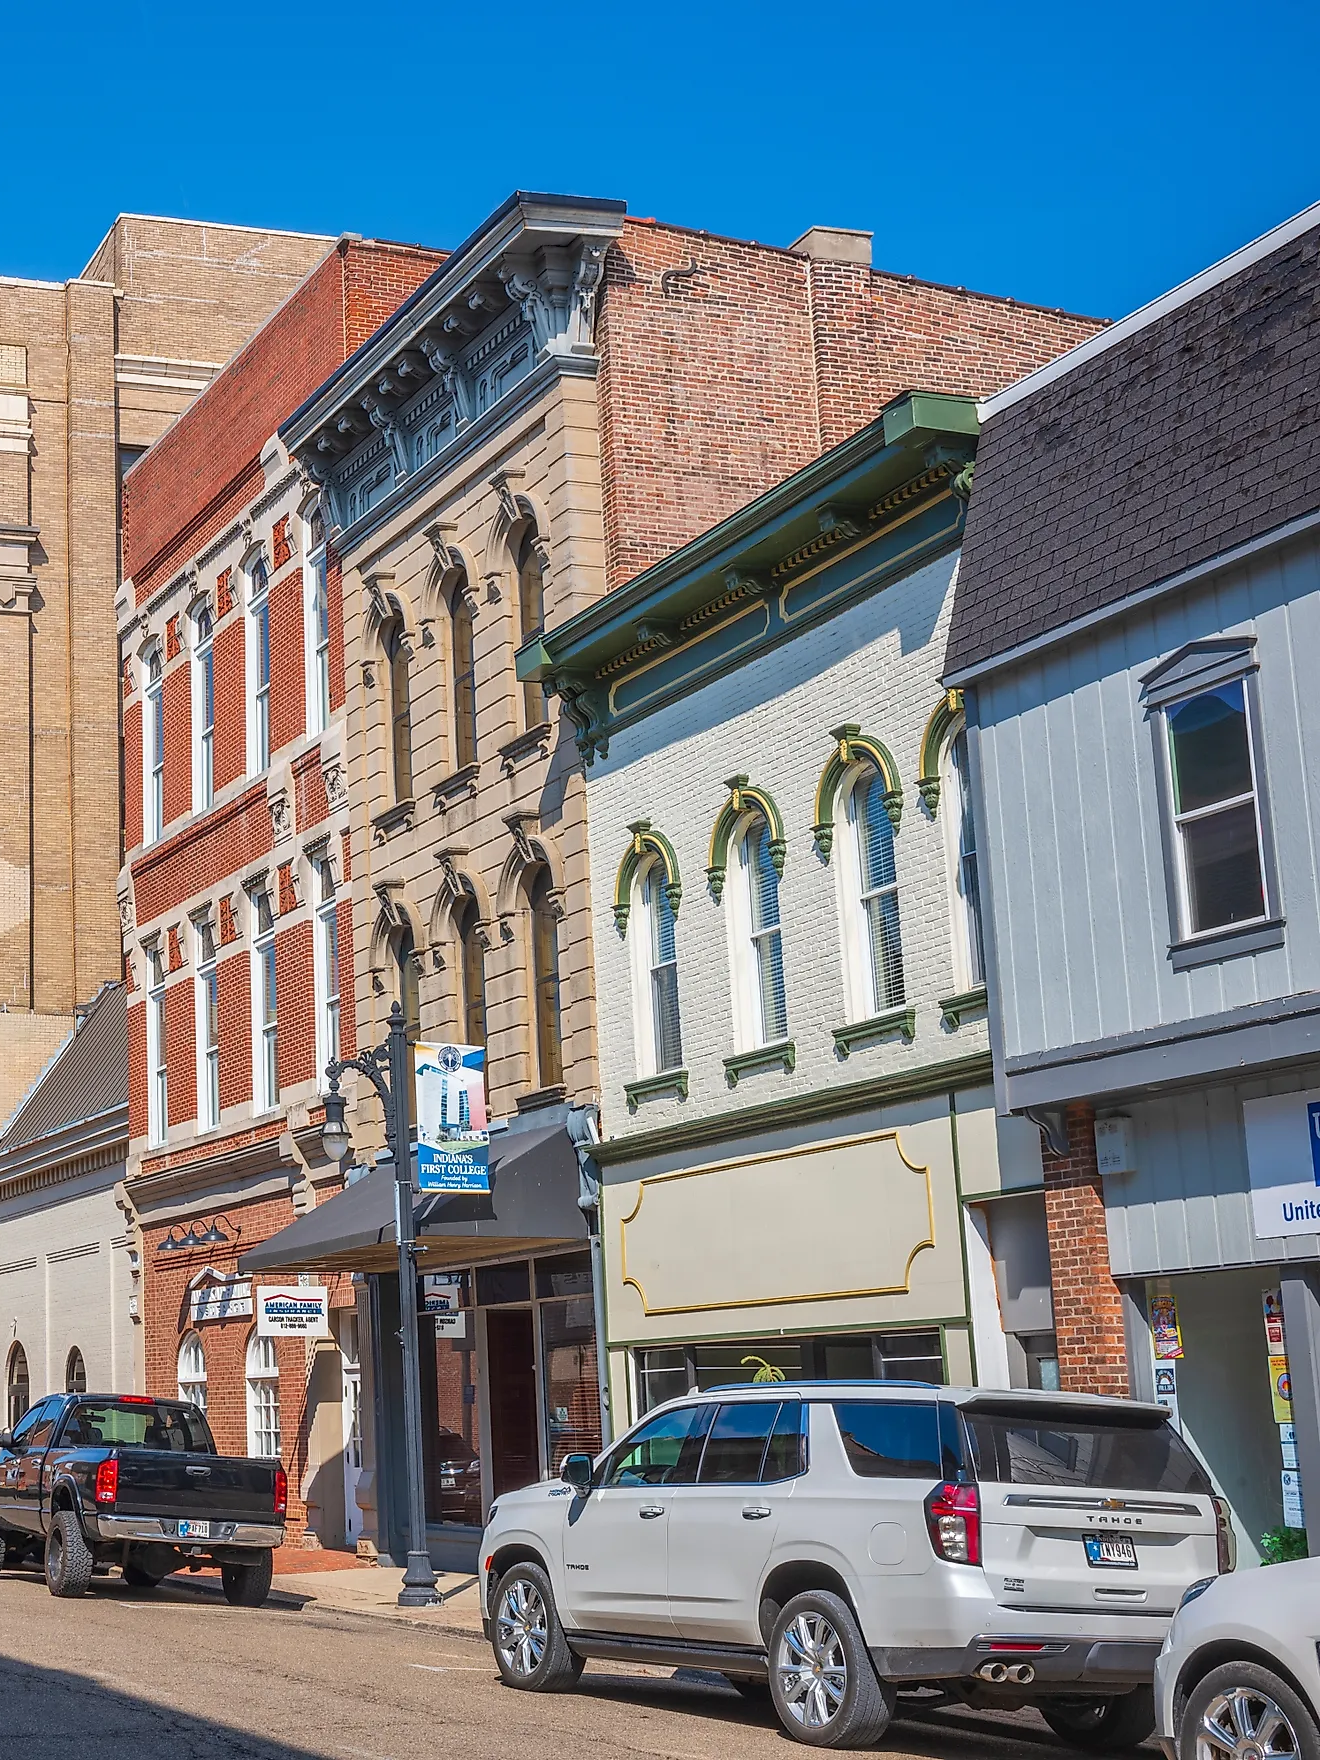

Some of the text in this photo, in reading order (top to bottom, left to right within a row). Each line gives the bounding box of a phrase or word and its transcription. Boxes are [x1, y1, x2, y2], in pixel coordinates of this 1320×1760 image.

[433, 1153, 473, 1164] INDIANA'S
[421, 1163, 487, 1175] FIRST COLLEGE
[462, 1175, 469, 1183] by
[1086, 1515, 1143, 1525] TAHOE
